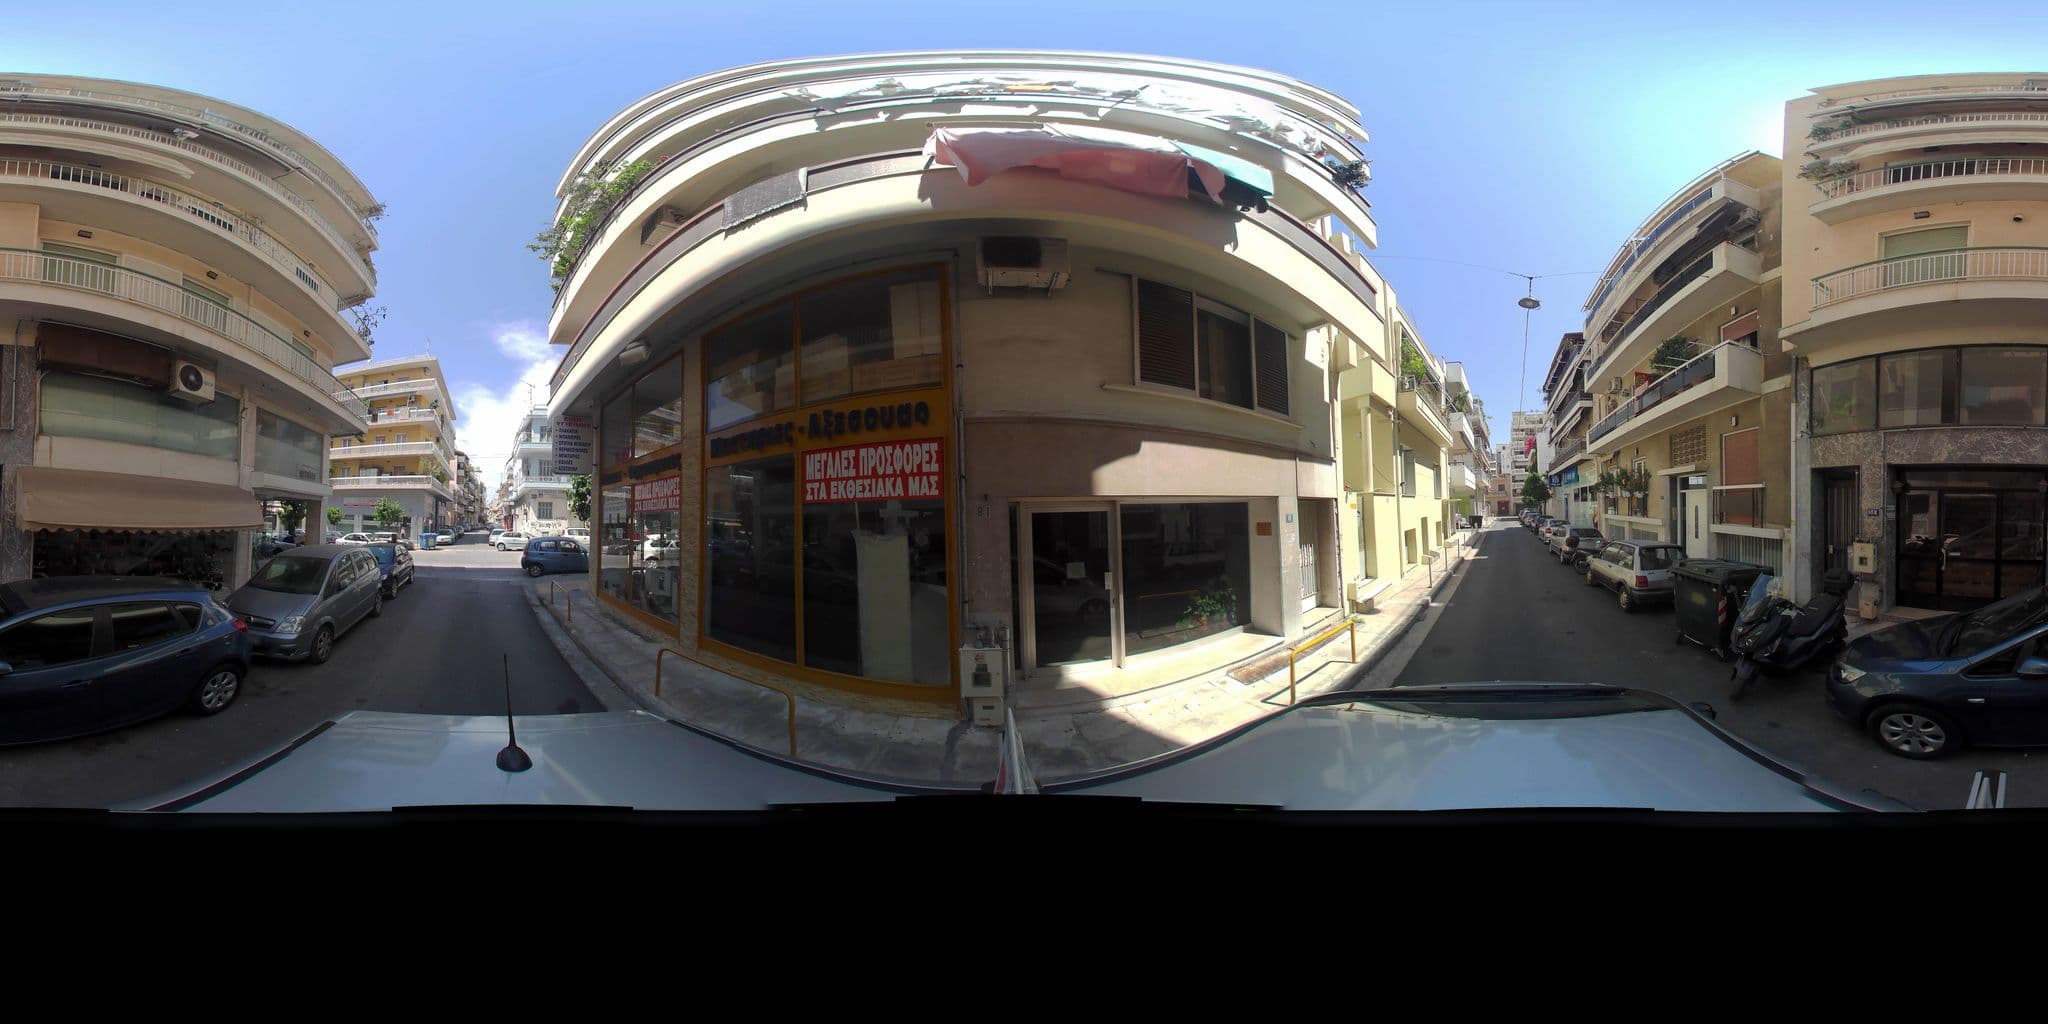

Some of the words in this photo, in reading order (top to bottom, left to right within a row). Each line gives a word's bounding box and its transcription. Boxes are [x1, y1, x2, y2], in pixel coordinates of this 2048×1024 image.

[806, 449, 856, 480] ΜΕΓΑΛΕΣ
[859, 443, 939, 476] ΠΡΟΣΦΟΡΕΣ
[806, 481, 828, 501] ΣΤΑ
[830, 476, 905, 499] ΕΚΘΕΣΙΑΚΑ
[908, 475, 939, 497] ΜΑΣ
